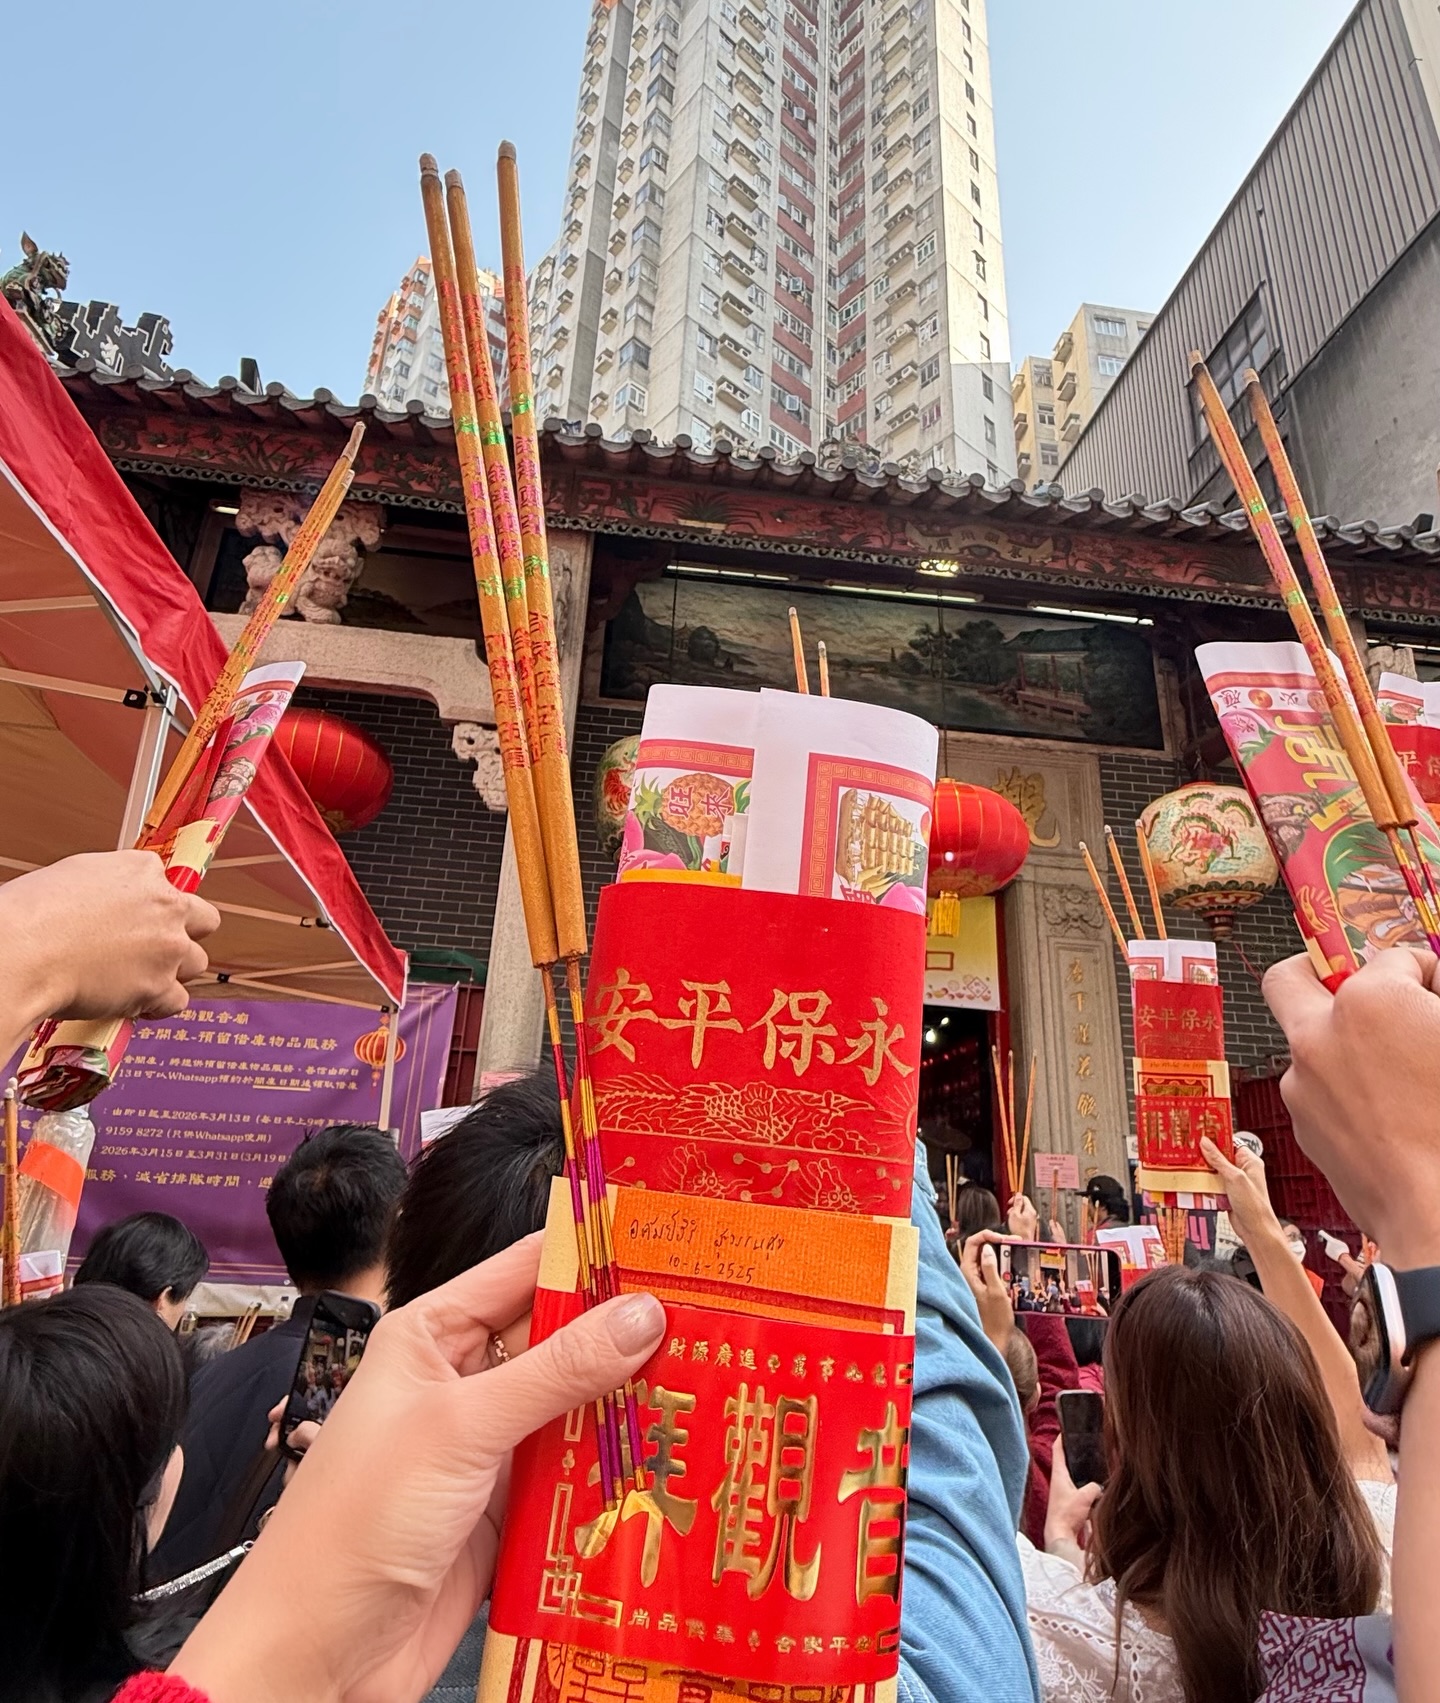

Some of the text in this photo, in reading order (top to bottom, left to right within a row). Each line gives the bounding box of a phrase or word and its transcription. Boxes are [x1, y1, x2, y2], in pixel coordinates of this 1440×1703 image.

[132, 1027, 338, 1050] 音開庫-預留借庫物品服務
[105, 1126, 133, 1137] 9159
[136, 1128, 163, 1138] 8272
[668, 1337, 757, 1371] 財源廣進
